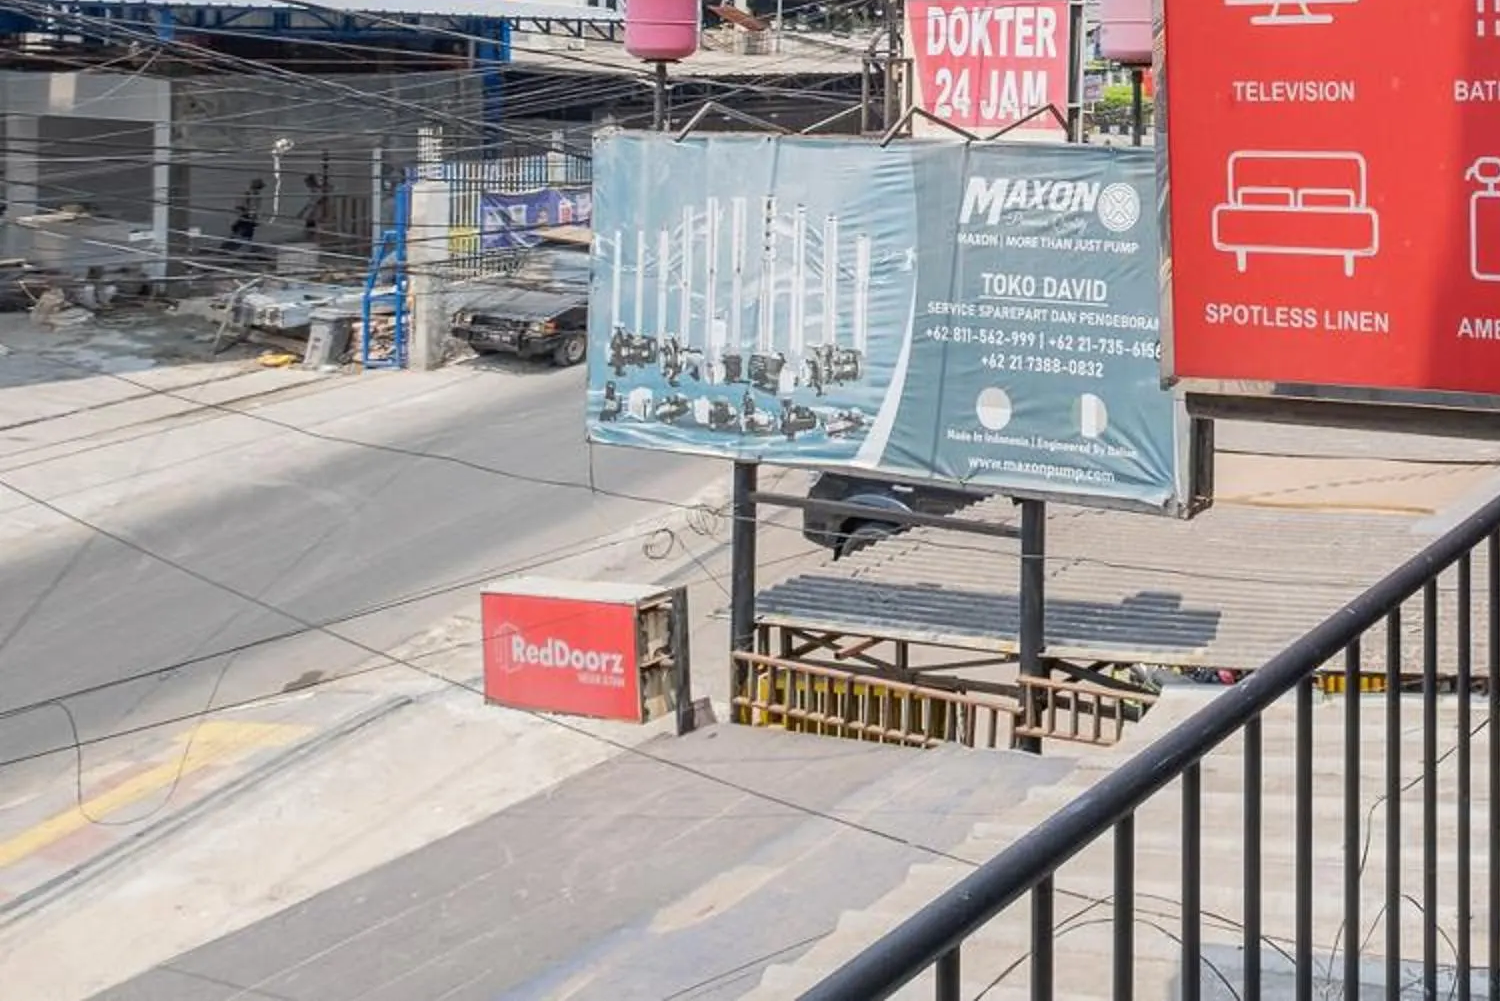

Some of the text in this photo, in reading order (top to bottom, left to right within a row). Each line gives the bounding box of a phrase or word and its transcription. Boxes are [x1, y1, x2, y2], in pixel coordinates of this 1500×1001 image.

[926, 6, 1057, 58] DOKTER
[934, 67, 1048, 121] 24 JAM
[1232, 80, 1356, 103] TELEVISION
[958, 176, 1100, 226] MAXON
[957, 231, 998, 247] MAXON
[1005, 235, 1039, 249] MORE
[1040, 236, 1073, 251] THAN
[1074, 238, 1103, 252] JUST
[1103, 240, 1139, 254] PUMP
[981, 272, 1107, 302] TOKO DAVID
[927, 301, 977, 316] SERVICE
[978, 304, 1049, 322] SPAREPART
[1050, 309, 1077, 324] DAN
[1204, 302, 1389, 333] SPOTLESS LINEN
[926, 325, 949, 341] +62
[1049, 334, 1074, 351] +62
[981, 353, 1005, 370] +62
[947, 429, 972, 442] Made
[968, 456, 1115, 483] www.maxonpump.com
[511, 633, 625, 674] RedDoorz
